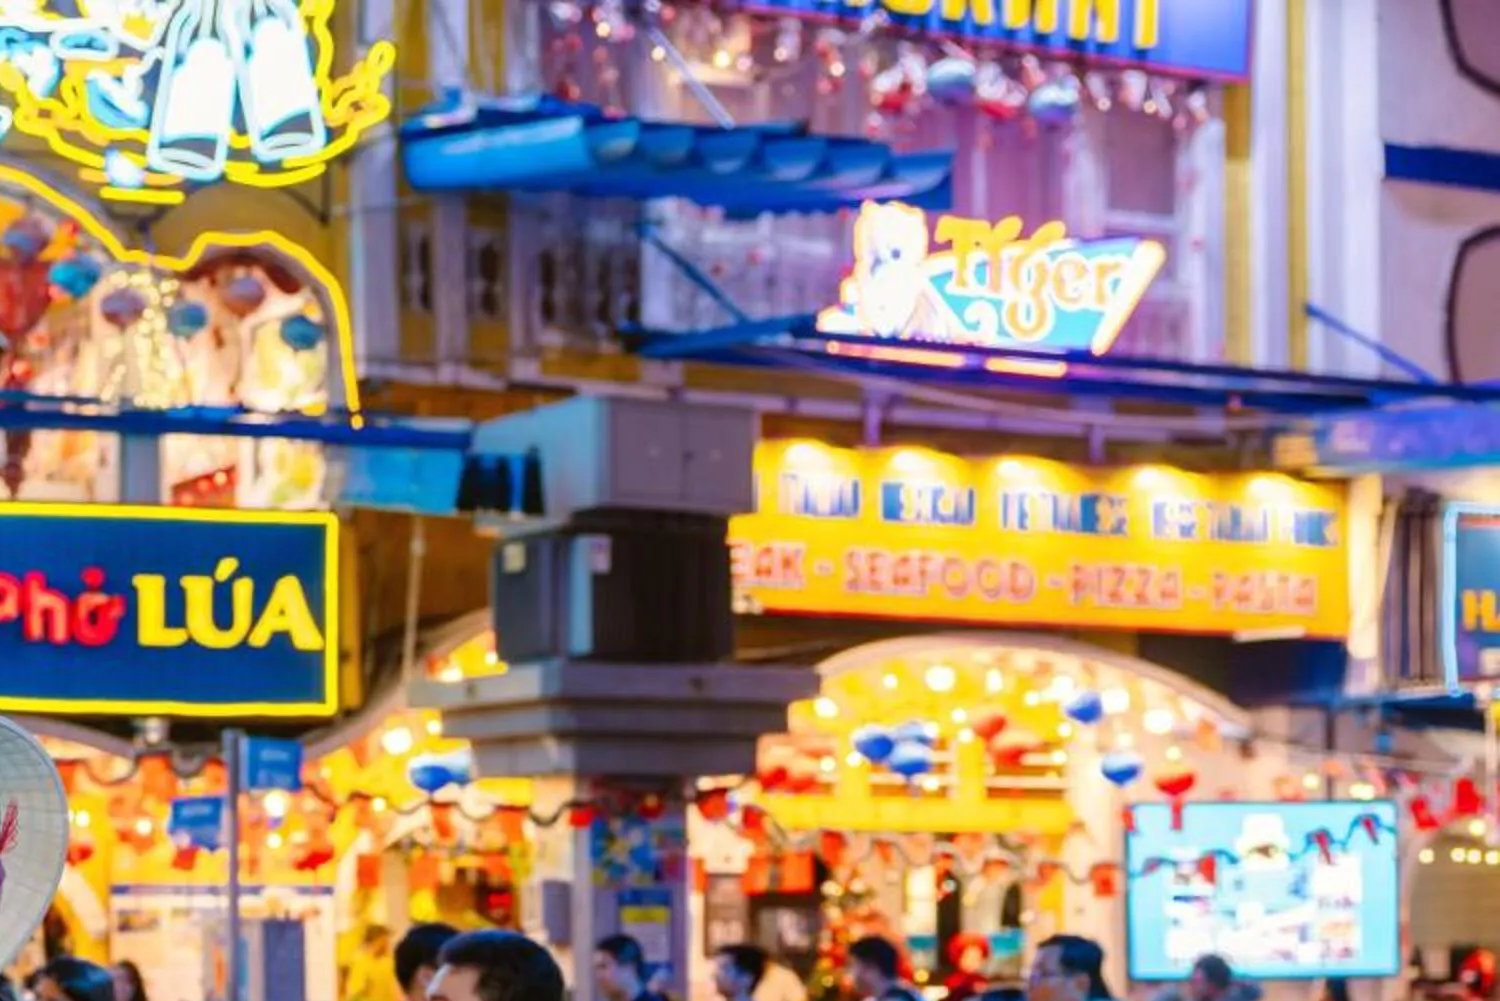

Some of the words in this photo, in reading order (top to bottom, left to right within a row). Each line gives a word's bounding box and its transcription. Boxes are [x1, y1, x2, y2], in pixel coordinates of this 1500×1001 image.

[132, 557, 325, 651] LÚA
[844, 545, 1037, 604] SEAFOOD
[1070, 561, 1184, 612] PIZZA
